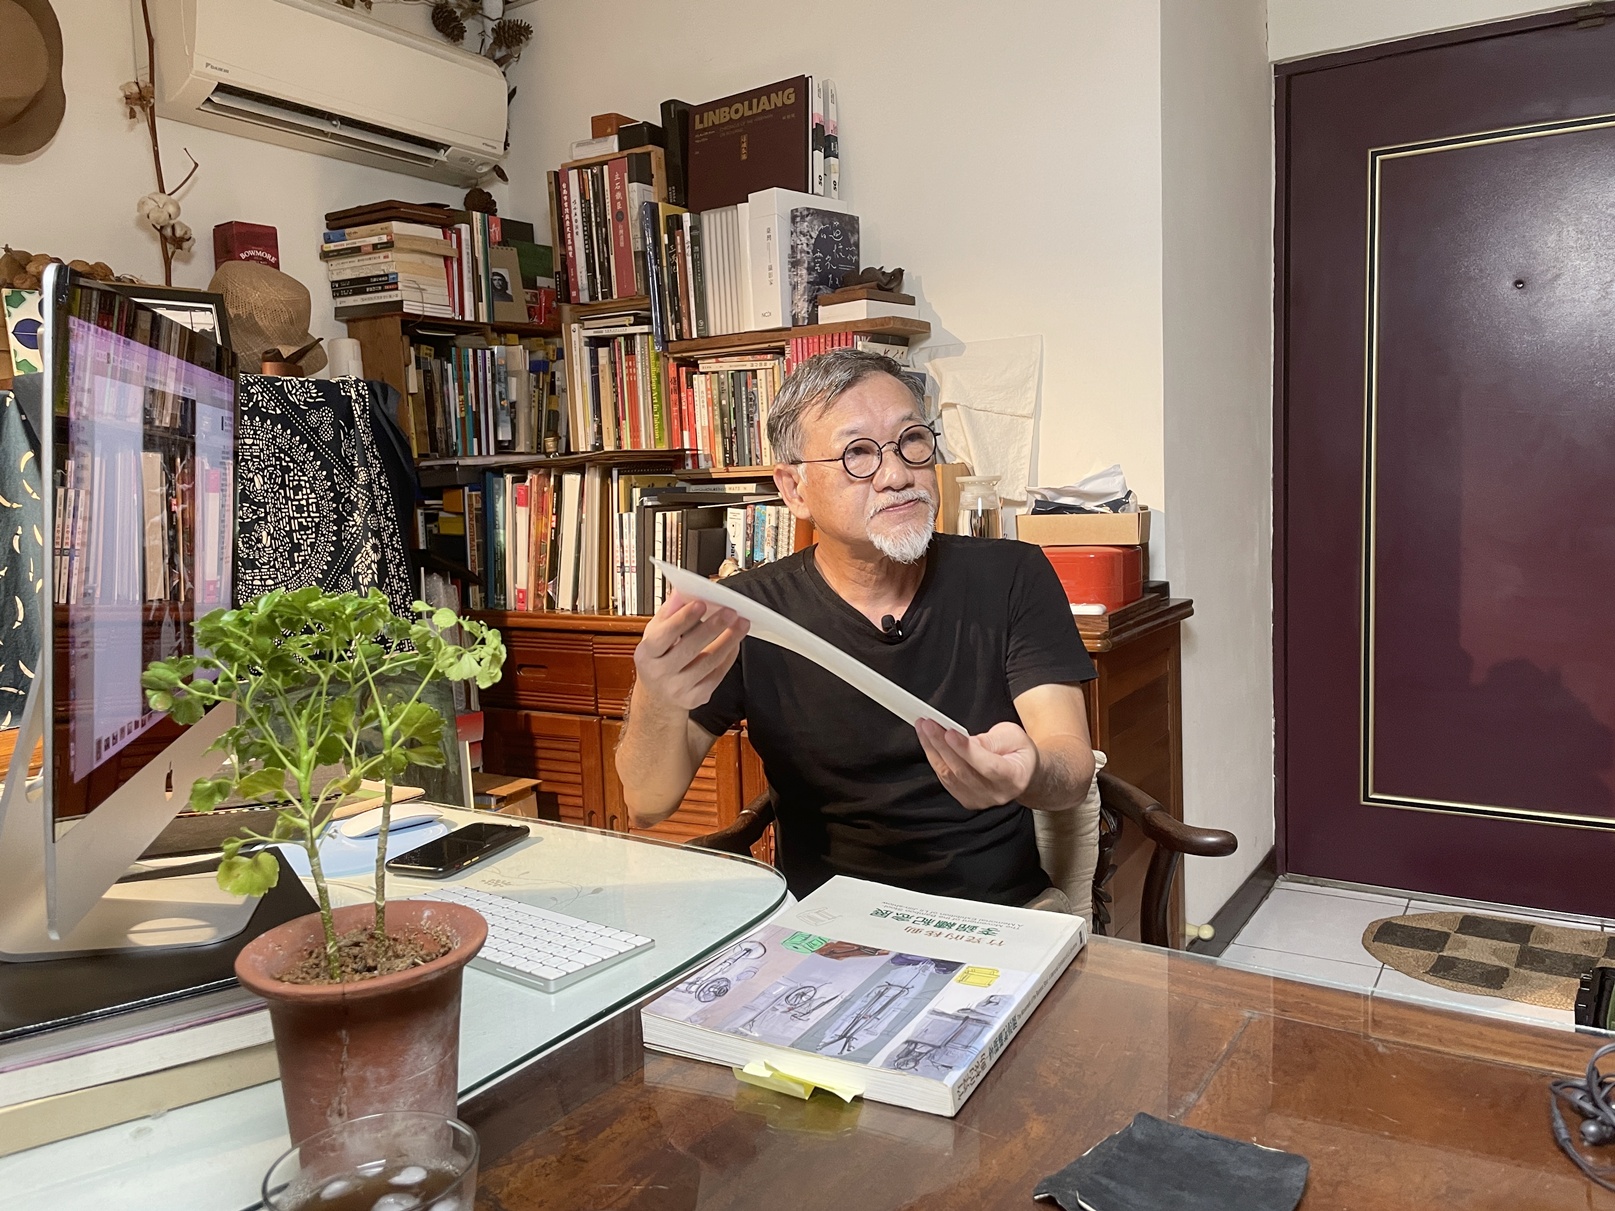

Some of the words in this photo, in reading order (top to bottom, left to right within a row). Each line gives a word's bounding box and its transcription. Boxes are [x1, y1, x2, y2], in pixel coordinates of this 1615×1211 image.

[694, 88, 796, 130] LINBOLIANG
[239, 249, 277, 264] BOWMORE
[870, 908, 1000, 936] 李錦繡紀念展
